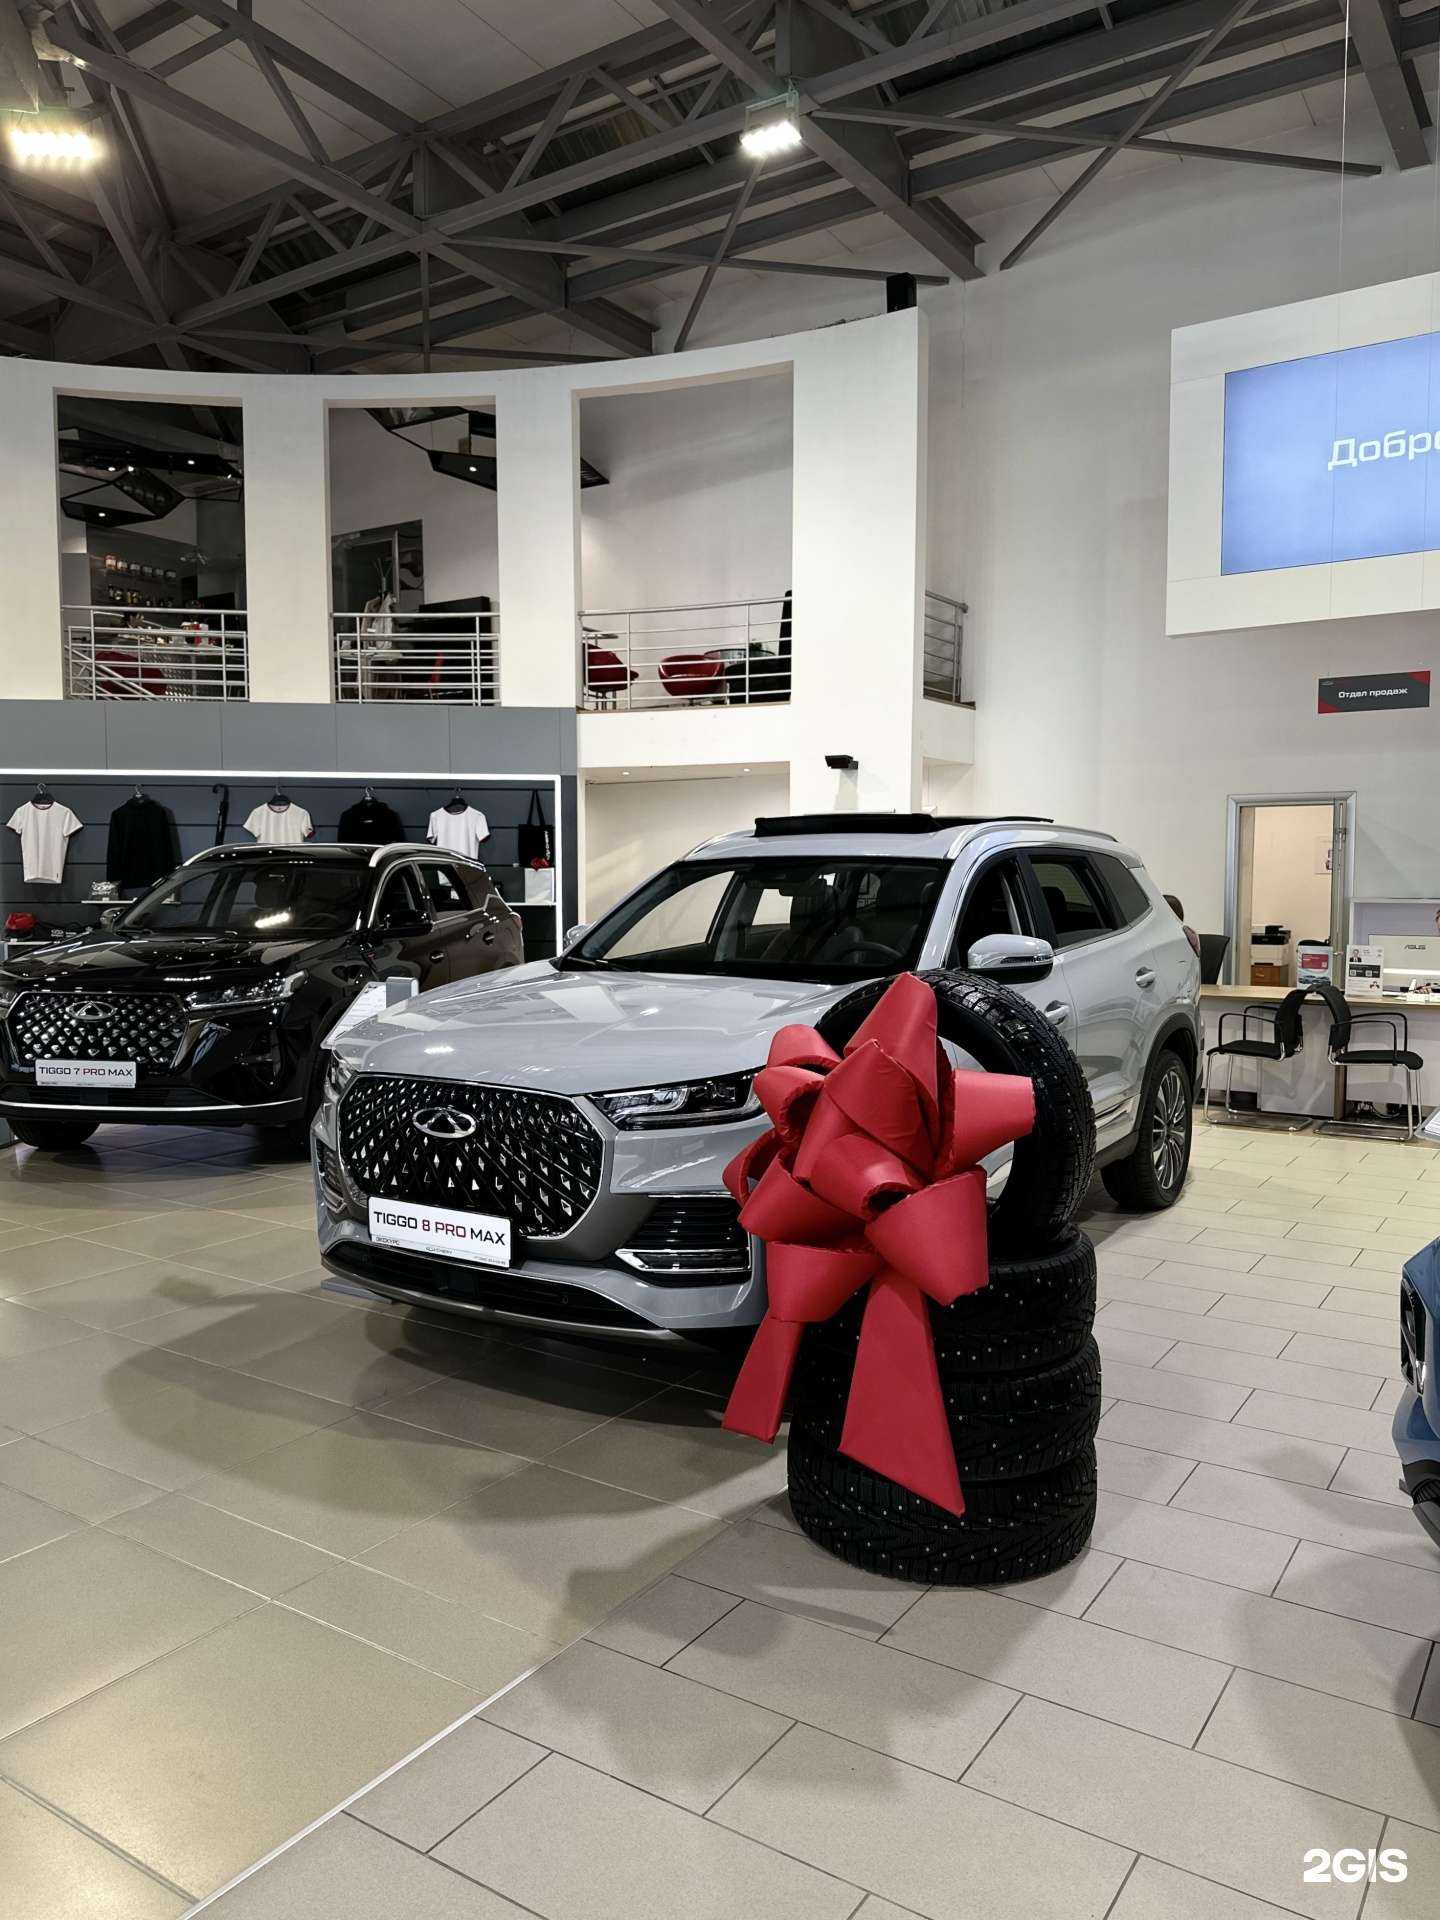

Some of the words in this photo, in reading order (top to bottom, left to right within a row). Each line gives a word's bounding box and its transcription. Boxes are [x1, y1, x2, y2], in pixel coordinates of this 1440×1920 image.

[1327, 430, 1440, 471] Добр
[1338, 691, 1367, 699] Отдел
[1369, 688, 1408, 697] продаж
[39, 1067, 71, 1075] TIGGO
[73, 1067, 80, 1075] 7
[83, 1068, 106, 1076] PRO
[108, 1069, 133, 1077] MAX
[373, 1211, 418, 1230] TIGGO
[421, 1219, 431, 1232] 8
[435, 1221, 467, 1239] PRO
[470, 1227, 506, 1246] MAX
